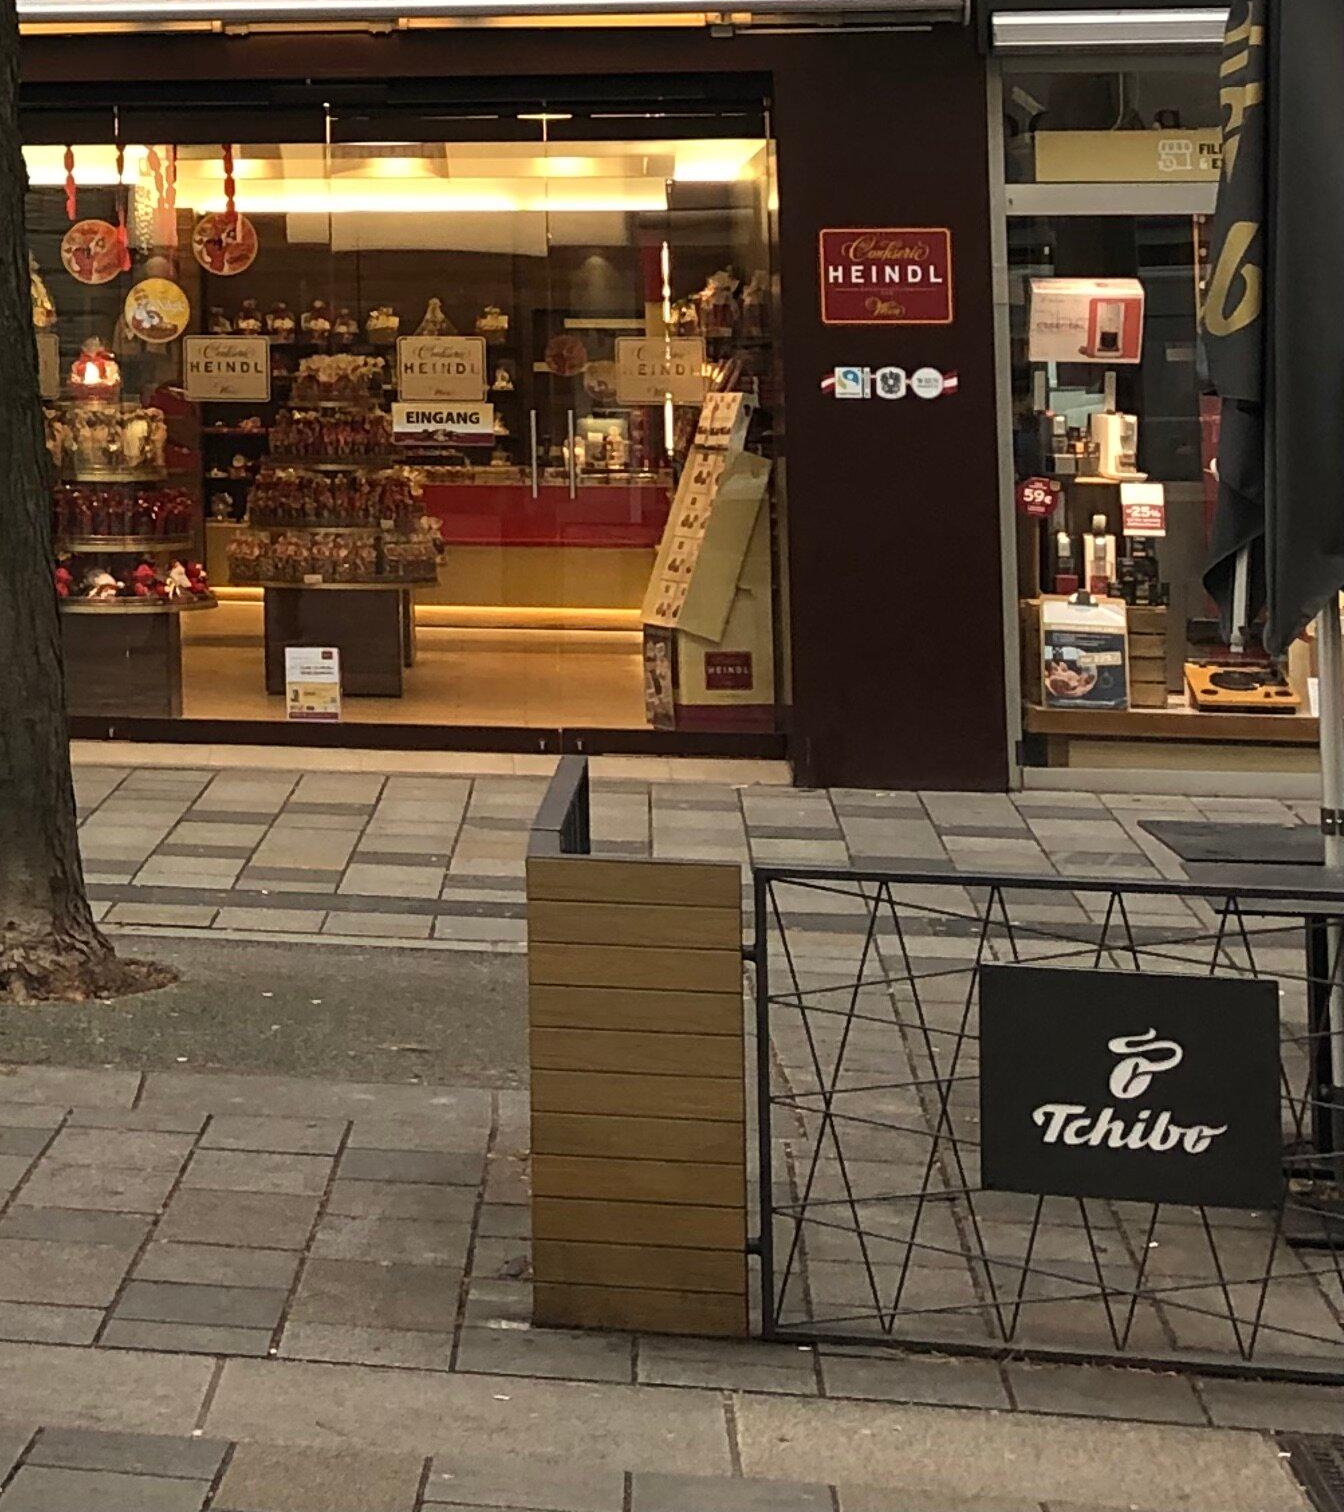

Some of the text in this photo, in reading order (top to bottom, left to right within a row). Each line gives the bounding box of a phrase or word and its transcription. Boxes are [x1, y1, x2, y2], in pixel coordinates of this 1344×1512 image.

[828, 265, 943, 284] HEINDL
[190, 361, 264, 373] HEINDL
[404, 362, 479, 375] HEINDL
[406, 411, 480, 425] EINGANG
[1032, 1103, 1228, 1155] Tchibo
